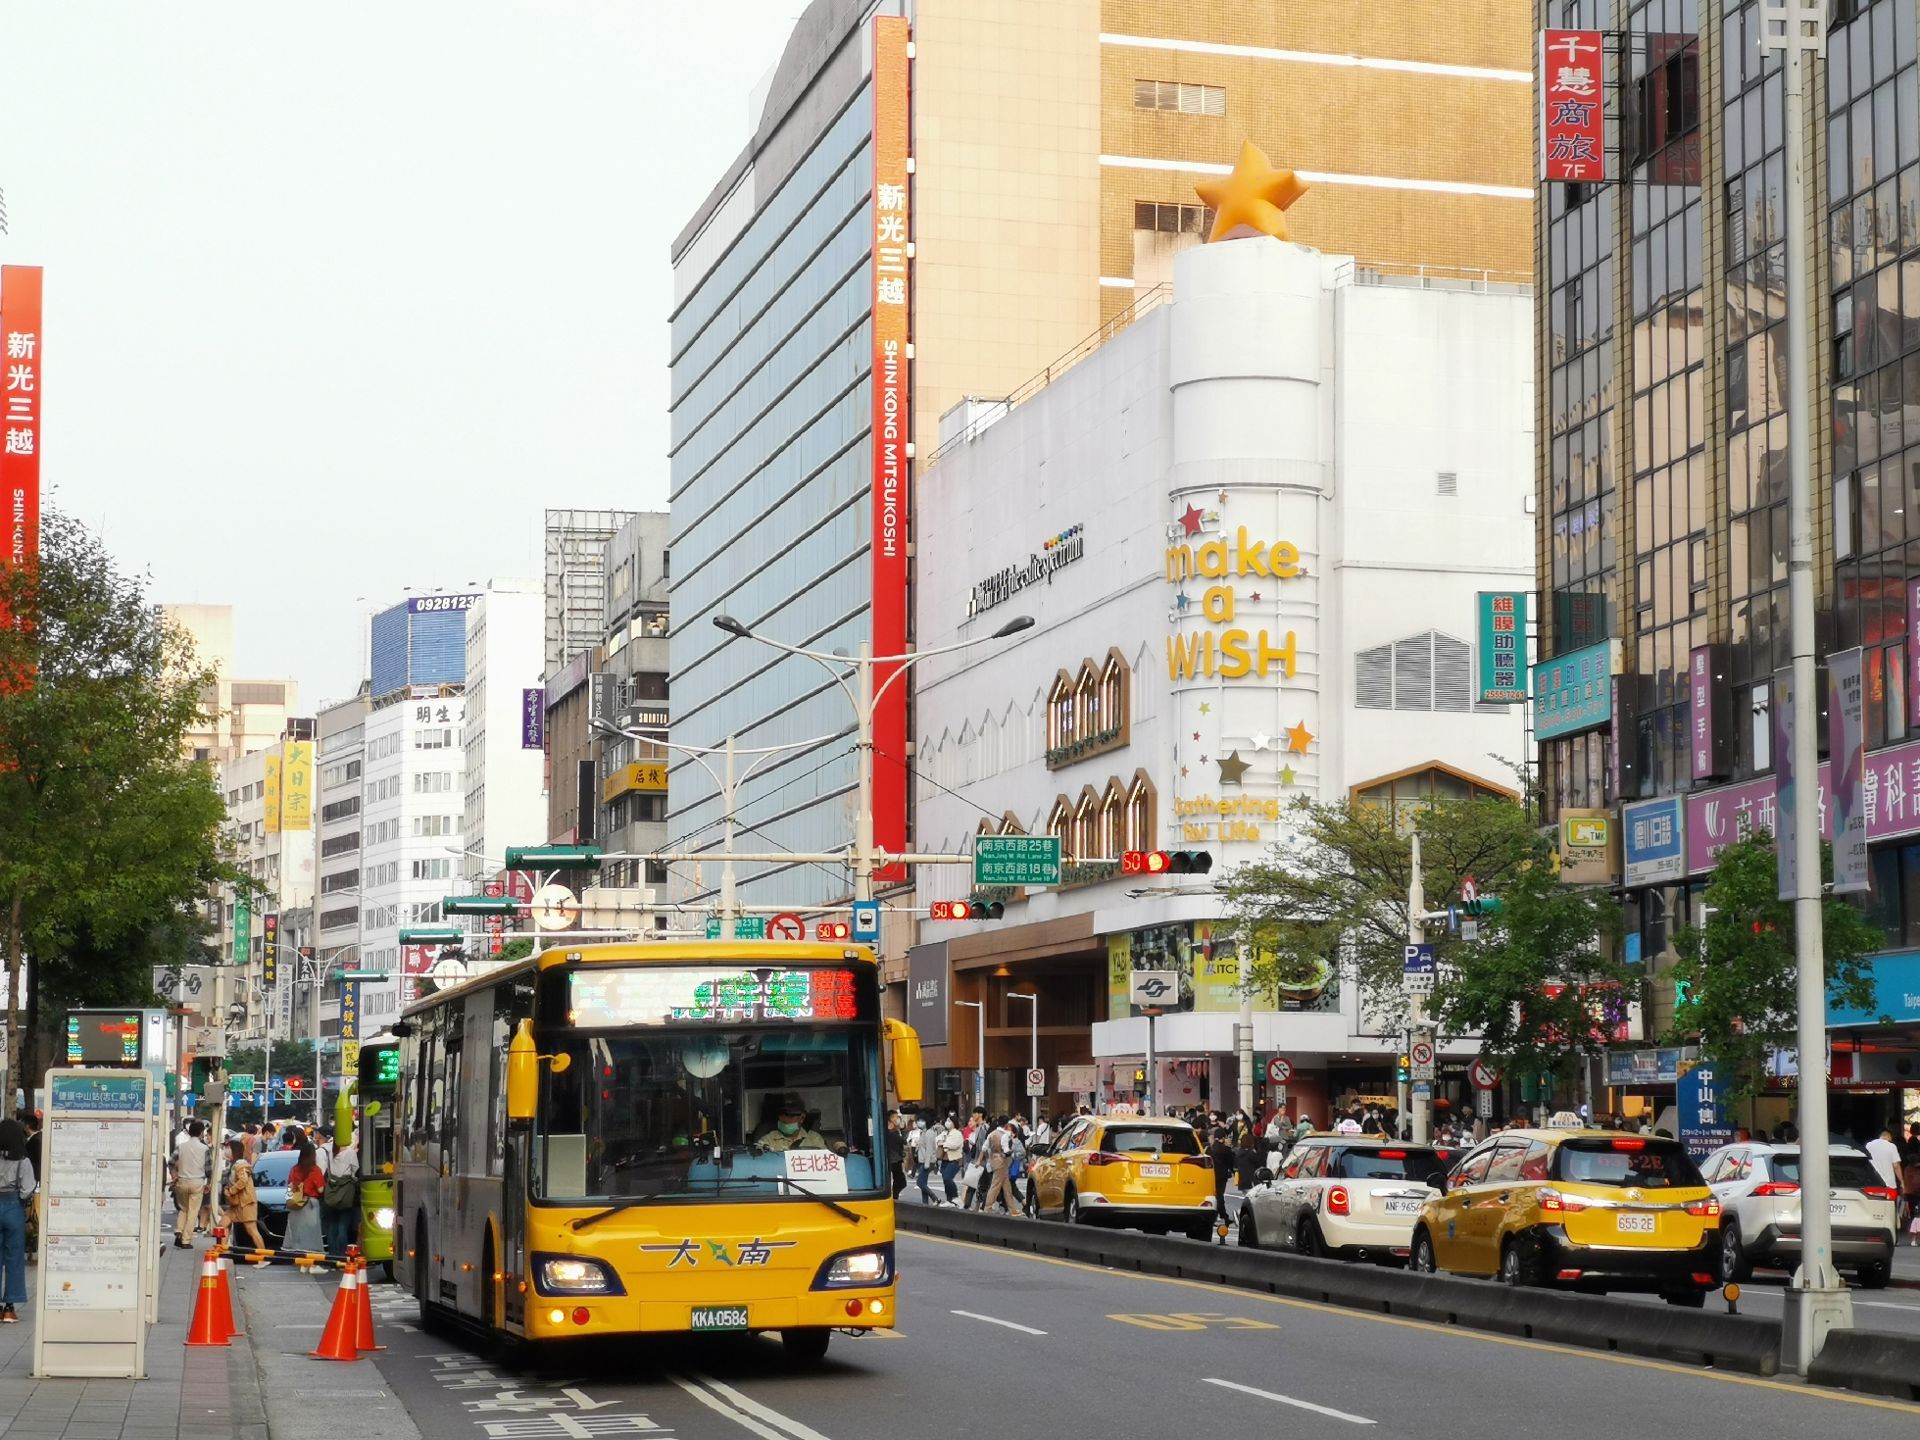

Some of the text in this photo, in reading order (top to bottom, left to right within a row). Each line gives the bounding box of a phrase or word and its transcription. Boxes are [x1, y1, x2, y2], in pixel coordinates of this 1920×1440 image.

[1548, 36, 1599, 162] 千慧商旅
[1562, 164, 1586, 178] 7F
[877, 183, 905, 305] 新光三越
[6, 331, 35, 455] 新光三越
[883, 340, 897, 557] SHIN KONG MITSUKOSHI
[13, 489, 24, 522] SHIN
[1166, 525, 1300, 584] make
[1203, 585, 1237, 623] a
[1493, 596, 1516, 687] 維膜助聽器
[1167, 629, 1297, 682] WISH
[288, 746, 309, 811] 大日宗
[1184, 820, 1261, 842] for Life
[1590, 831, 1605, 841] TMK
[982, 839, 1053, 852] 南京西路25巷
[982, 862, 1053, 874] 南京西路18巷
[1124, 854, 1141, 871] 50
[934, 904, 947, 918] 50
[819, 926, 830, 938] 50
[1405, 946, 1419, 964] P
[790, 1154, 840, 1174] 往北投
[1618, 1216, 1654, 1231] 655-2E
[640, 1236, 798, 1268] 大南
[691, 1308, 747, 1328] KKA-0586
